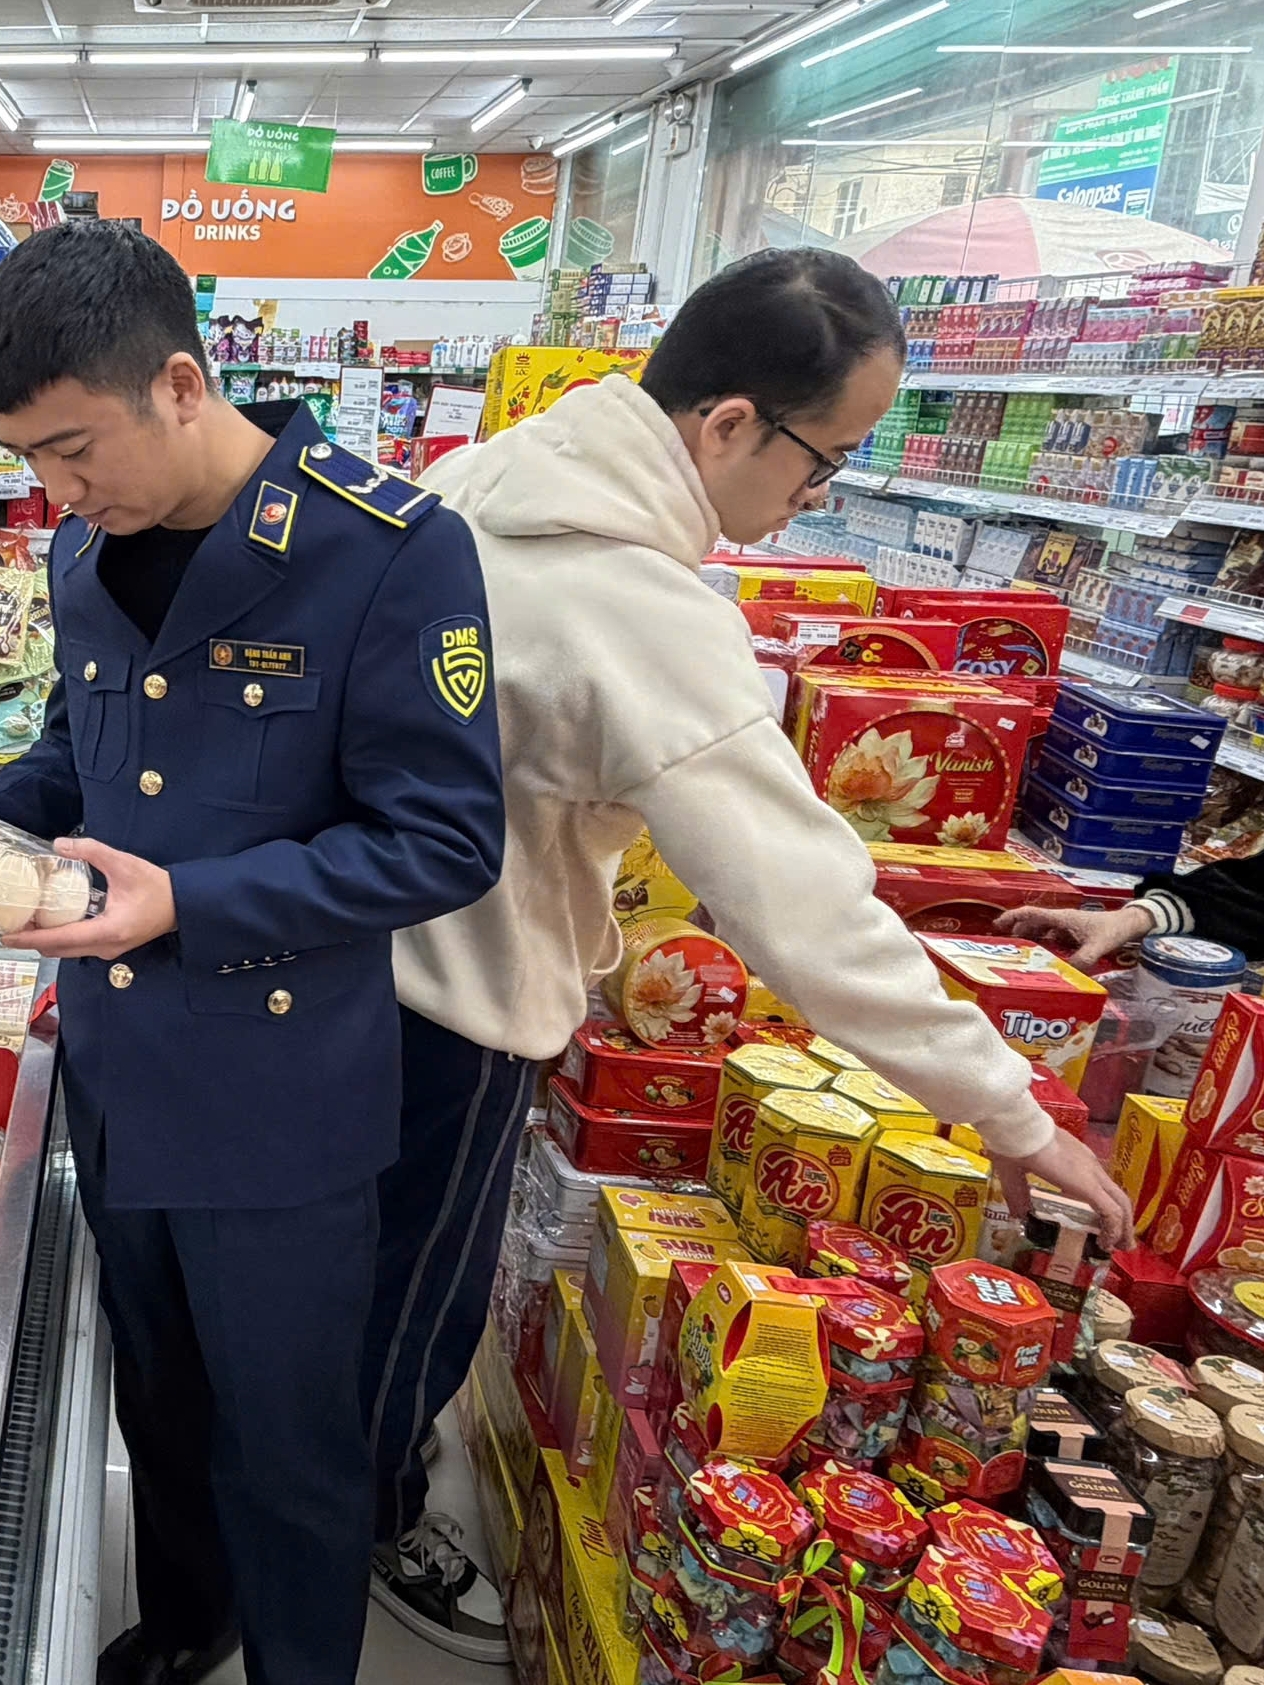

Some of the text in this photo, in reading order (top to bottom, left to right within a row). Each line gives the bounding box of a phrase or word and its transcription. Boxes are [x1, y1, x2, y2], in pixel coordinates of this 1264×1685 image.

[430, 166, 456, 180] COFFEE
[162, 189, 296, 221] ĐỒ UỐNG
[1057, 183, 1123, 208] Salonpas
[194, 224, 262, 241] DRINKS
[442, 627, 478, 648] DMS
[953, 659, 1017, 675] COSY
[927, 751, 996, 773] Vanish
[1001, 1010, 1070, 1041] Tipo
[759, 1155, 832, 1213] An
[878, 1199, 956, 1258] An
[655, 1237, 716, 1256] SURI
[1032, 1405, 1071, 1417] OLDEN
[1067, 1478, 1121, 1495] GOLDEN
[1077, 1577, 1130, 1594] GOLDEN
